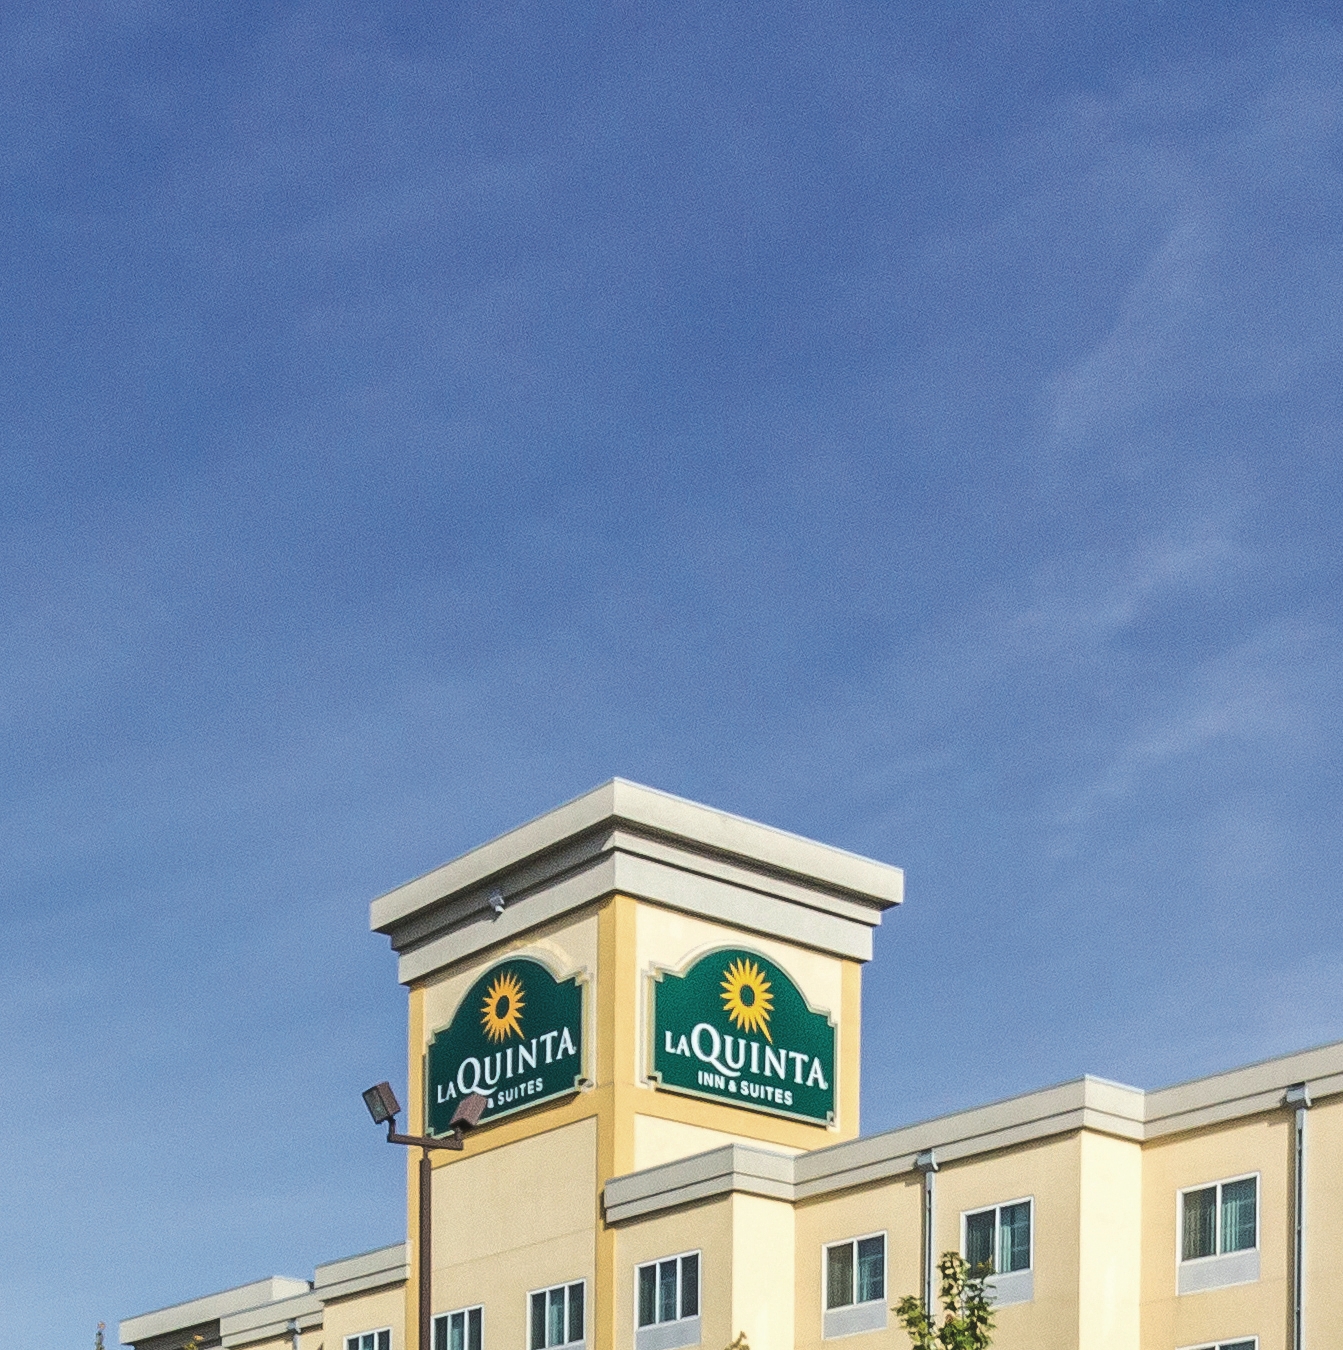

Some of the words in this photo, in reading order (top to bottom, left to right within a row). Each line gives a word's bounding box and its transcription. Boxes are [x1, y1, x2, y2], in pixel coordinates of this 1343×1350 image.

[437, 1080, 458, 1104] LA
[457, 1026, 576, 1096] QUINTA
[664, 1030, 691, 1058] LA
[690, 1022, 829, 1091] QUINTA
[497, 1077, 544, 1106] SUITES
[697, 1070, 725, 1090] INN
[727, 1079, 738, 1093] &
[740, 1080, 794, 1106] SUITES
